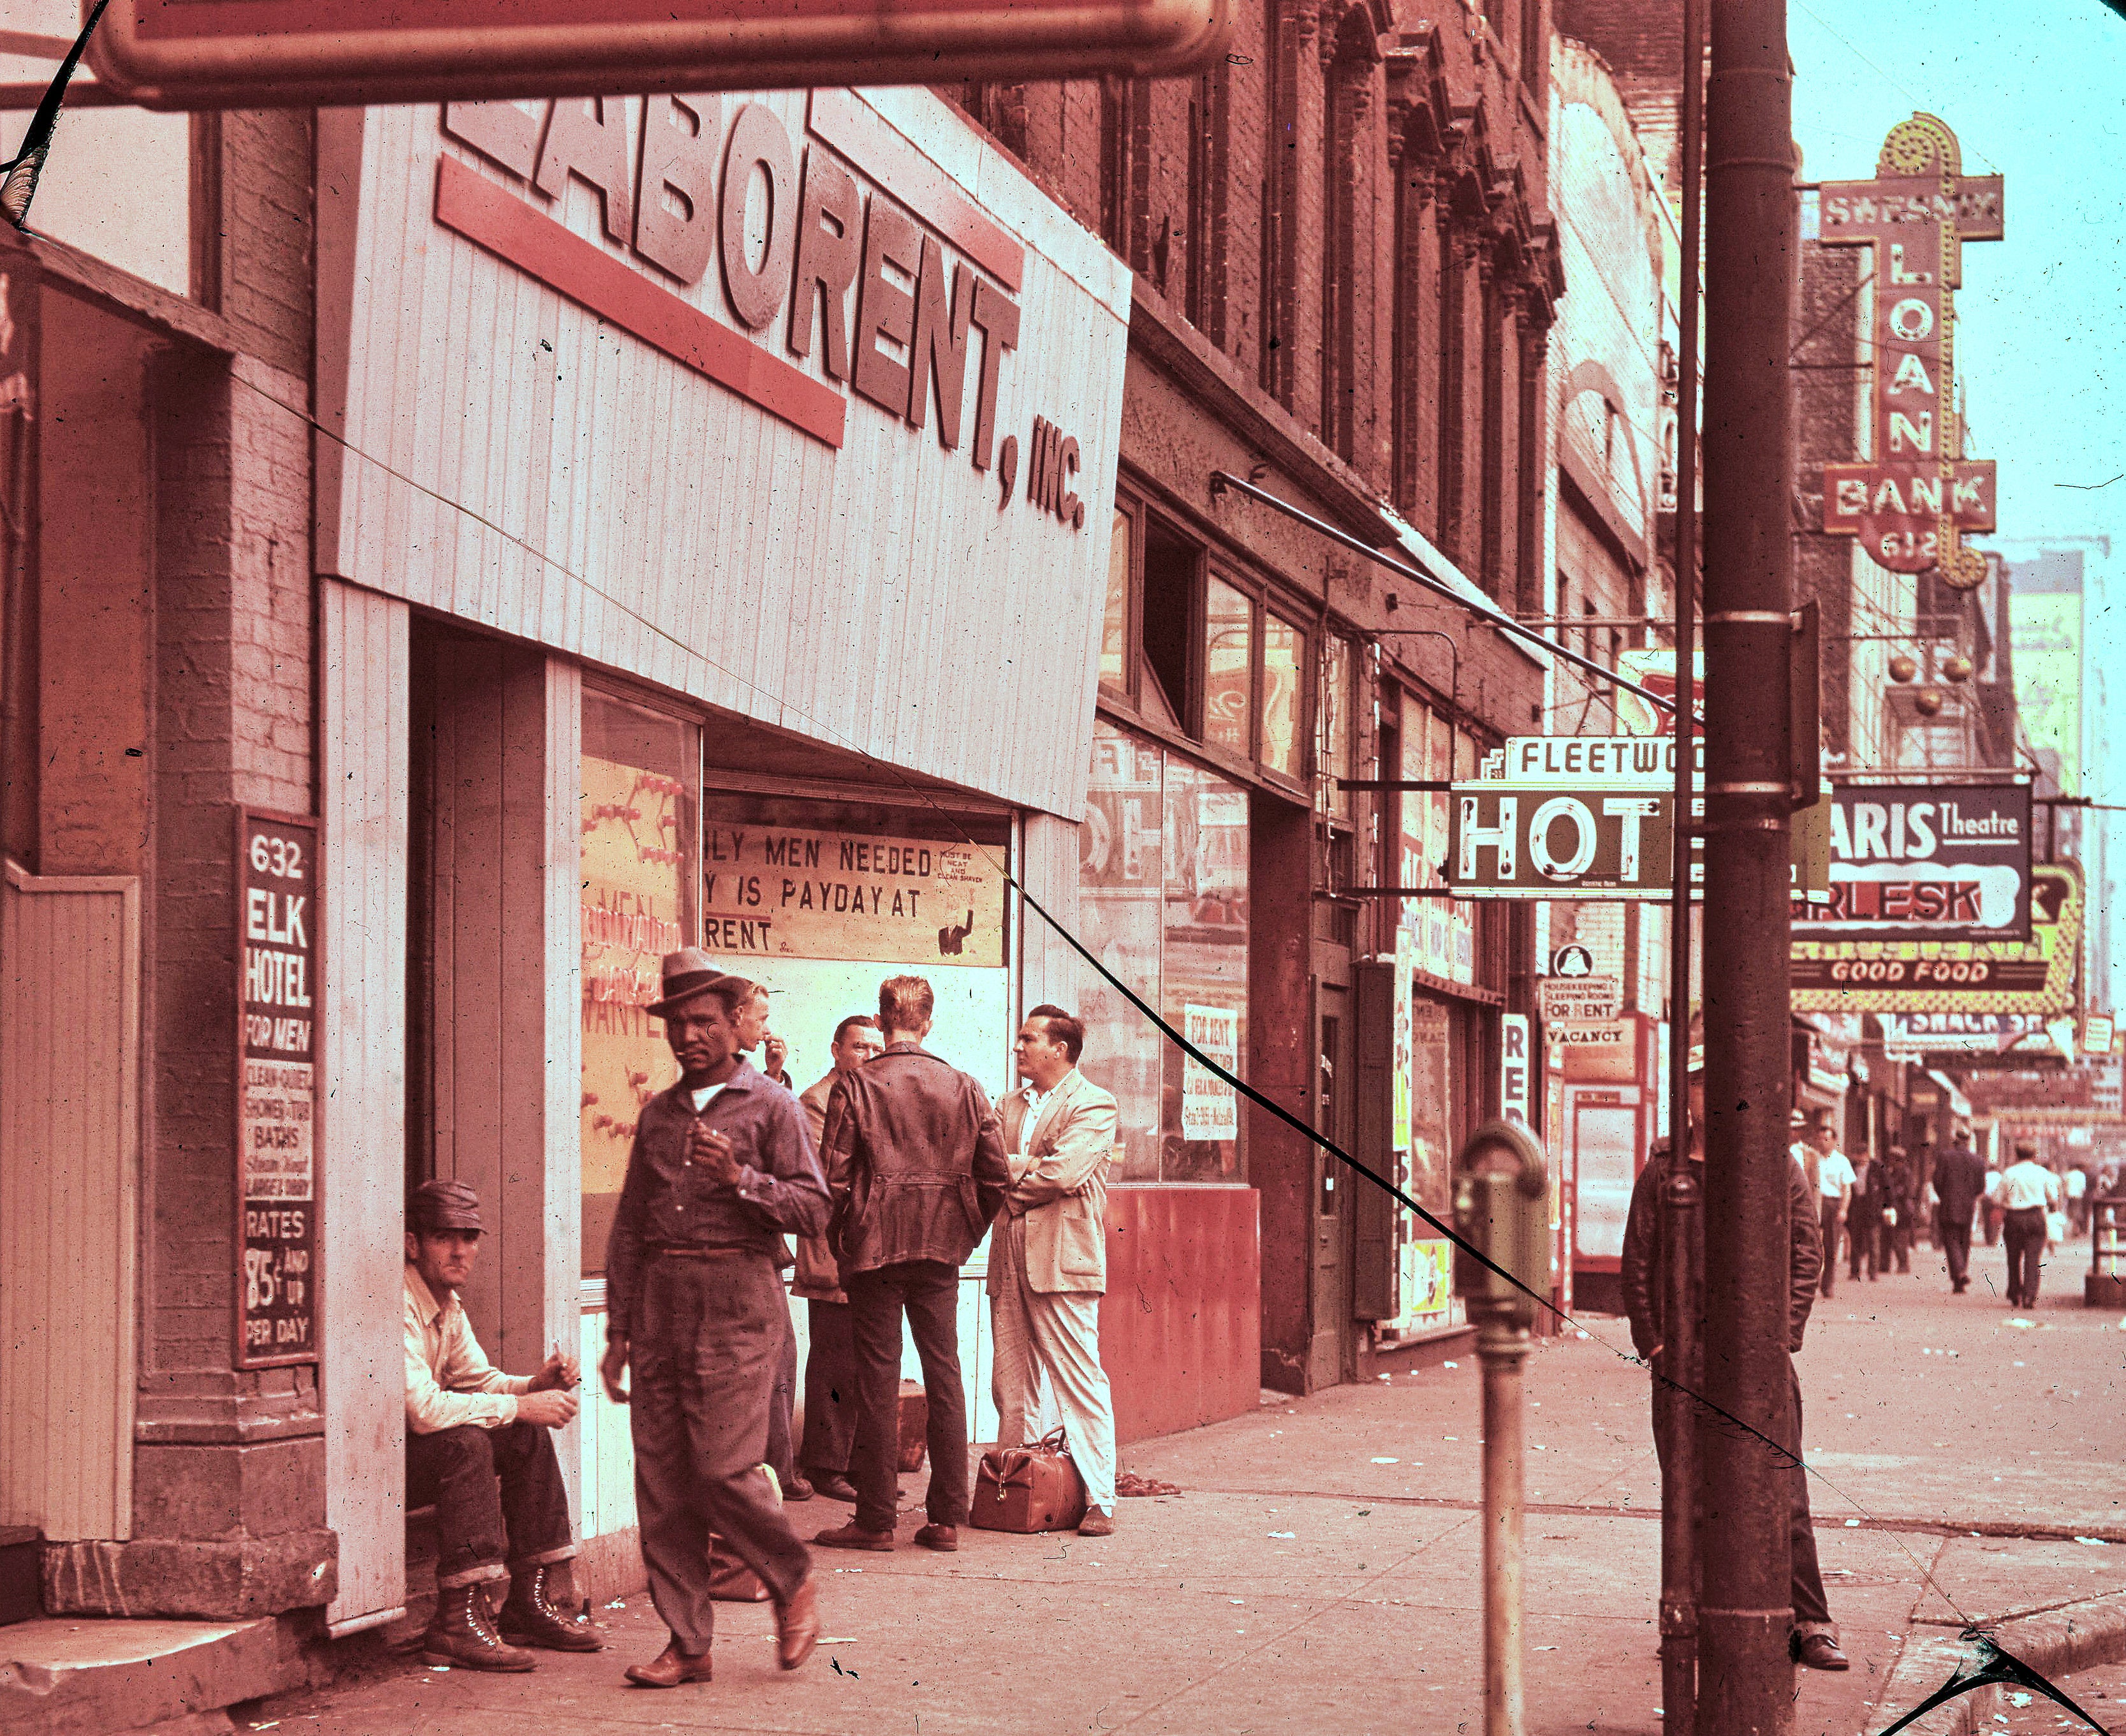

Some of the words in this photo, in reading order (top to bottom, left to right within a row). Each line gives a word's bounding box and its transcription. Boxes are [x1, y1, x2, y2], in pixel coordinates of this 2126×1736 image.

[1888, 244, 1934, 452] LOAN
[1028, 415, 1085, 529] INC.
[1837, 477, 1987, 515] BANK
[1881, 532, 1937, 557] 612
[1830, 803, 1937, 858] ARIS
[1939, 802, 2019, 835] Theatre
[251, 835, 303, 879] 632
[705, 830, 744, 861] ILY
[765, 835, 819, 869] MEN
[840, 841, 931, 877] NEEDED
[738, 876, 761, 906] IS
[781, 879, 883, 915] PAYDAY
[891, 889, 920, 918] AT
[1789, 881, 1983, 921] RLESK
[247, 887, 307, 948] ELK
[705, 918, 772, 951] RENT
[246, 947, 311, 1007] HOTEL
[1831, 962, 1905, 983] GOOD
[1914, 962, 1990, 983] FOOD
[1545, 1002, 1570, 1017] FOR
[1574, 1003, 1614, 1017] RENT
[246, 1014, 272, 1048] FOR
[272, 1018, 311, 1052] MEN
[1192, 1015, 1206, 1045] FOR
[1548, 1029, 1624, 1043] VACANCY
[247, 1210, 305, 1239] RATES
[246, 1318, 271, 1345] PER
[277, 1317, 309, 1343] DAY
